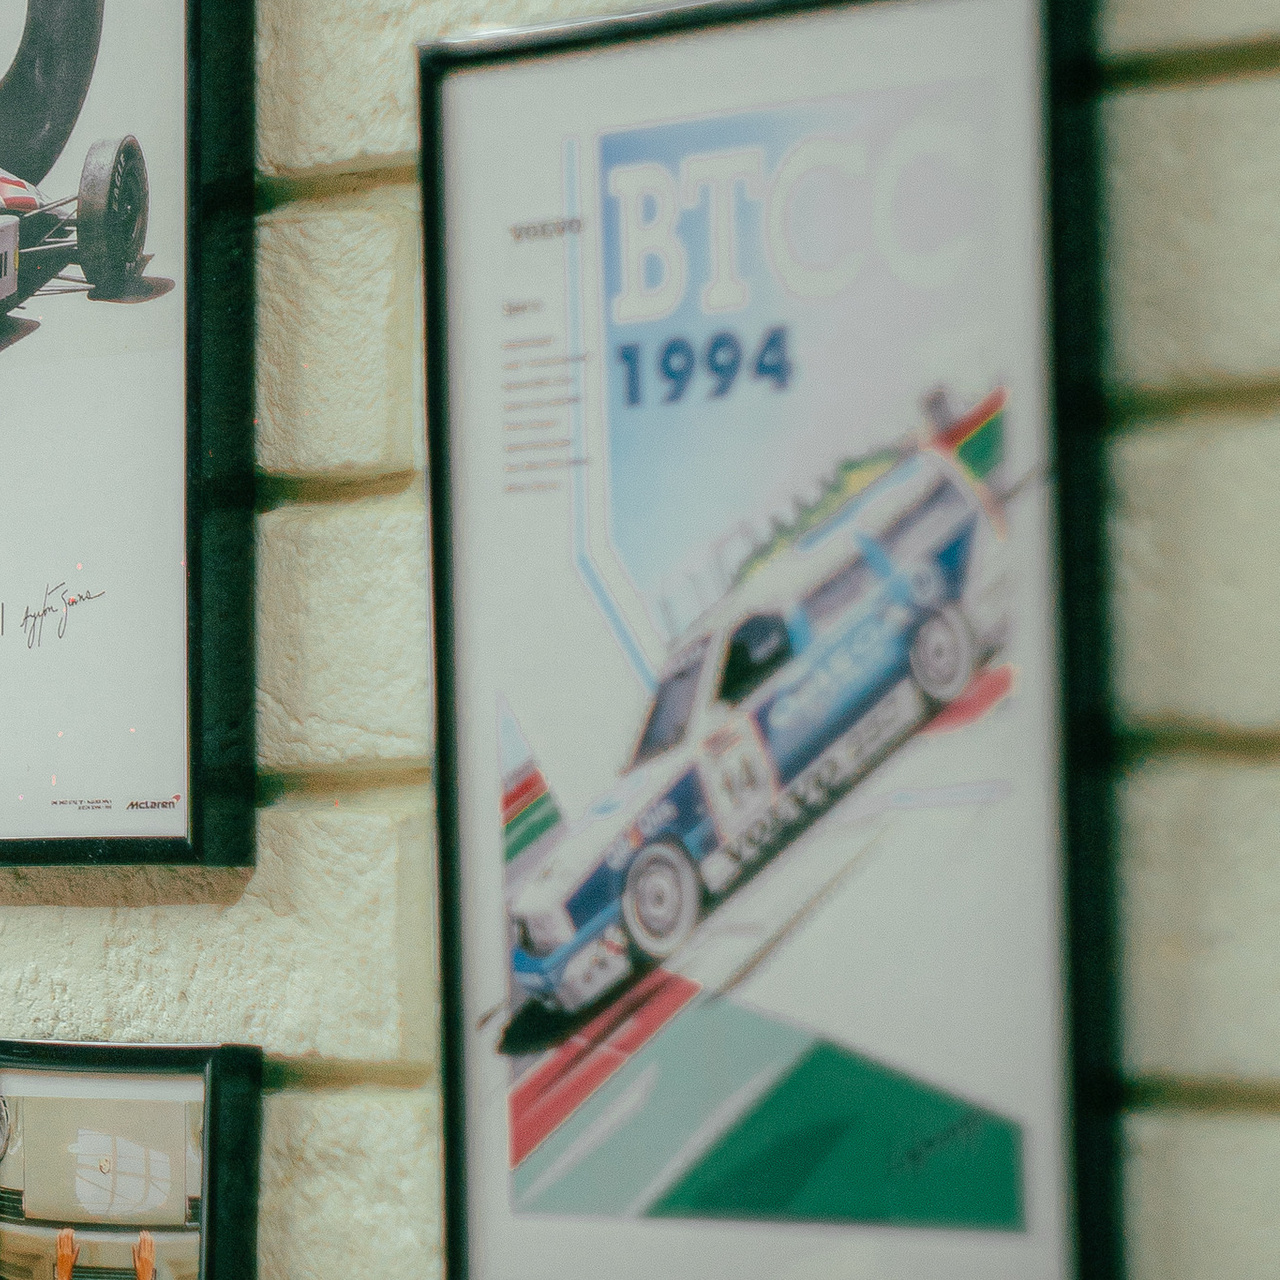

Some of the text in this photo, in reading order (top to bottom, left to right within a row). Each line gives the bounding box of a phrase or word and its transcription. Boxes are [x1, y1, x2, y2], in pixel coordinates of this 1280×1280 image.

[608, 118, 980, 326] BTCC
[616, 326, 796, 409] 1994
[126, 800, 176, 810] McLaren
